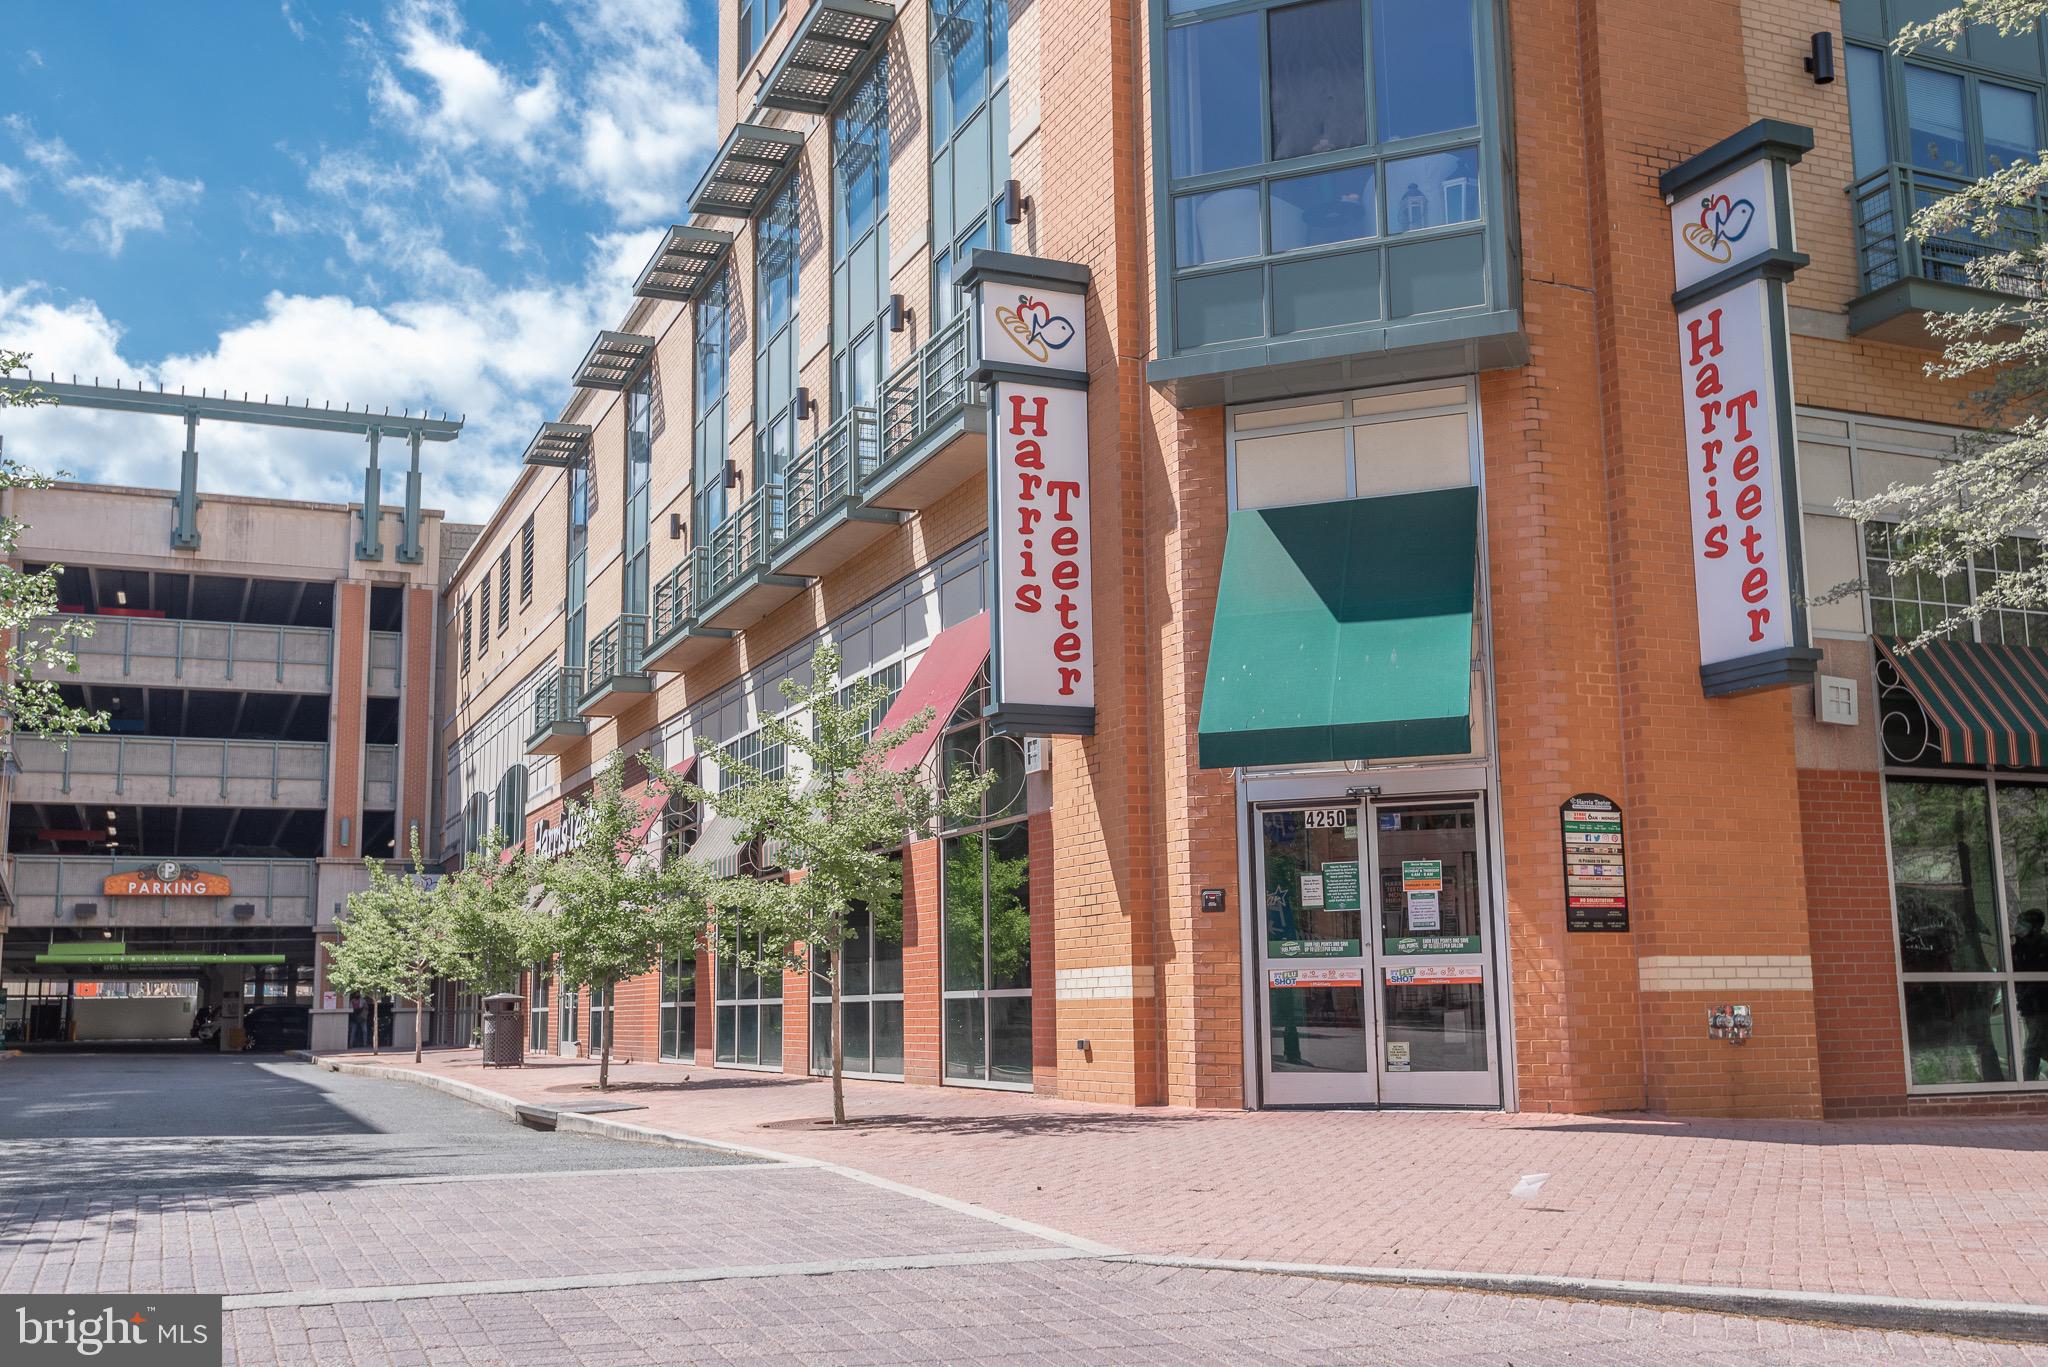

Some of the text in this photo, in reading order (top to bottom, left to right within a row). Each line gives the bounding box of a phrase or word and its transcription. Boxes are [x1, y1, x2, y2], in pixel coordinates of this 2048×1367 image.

[1687, 307, 1771, 643] Harris Teeter
[1008, 394, 1082, 696] Harris Teeter
[1306, 810, 1345, 827] 4250
[164, 862, 176, 878] P
[128, 882, 207, 894] PARKING
[1274, 978, 1297, 986] SHOT
